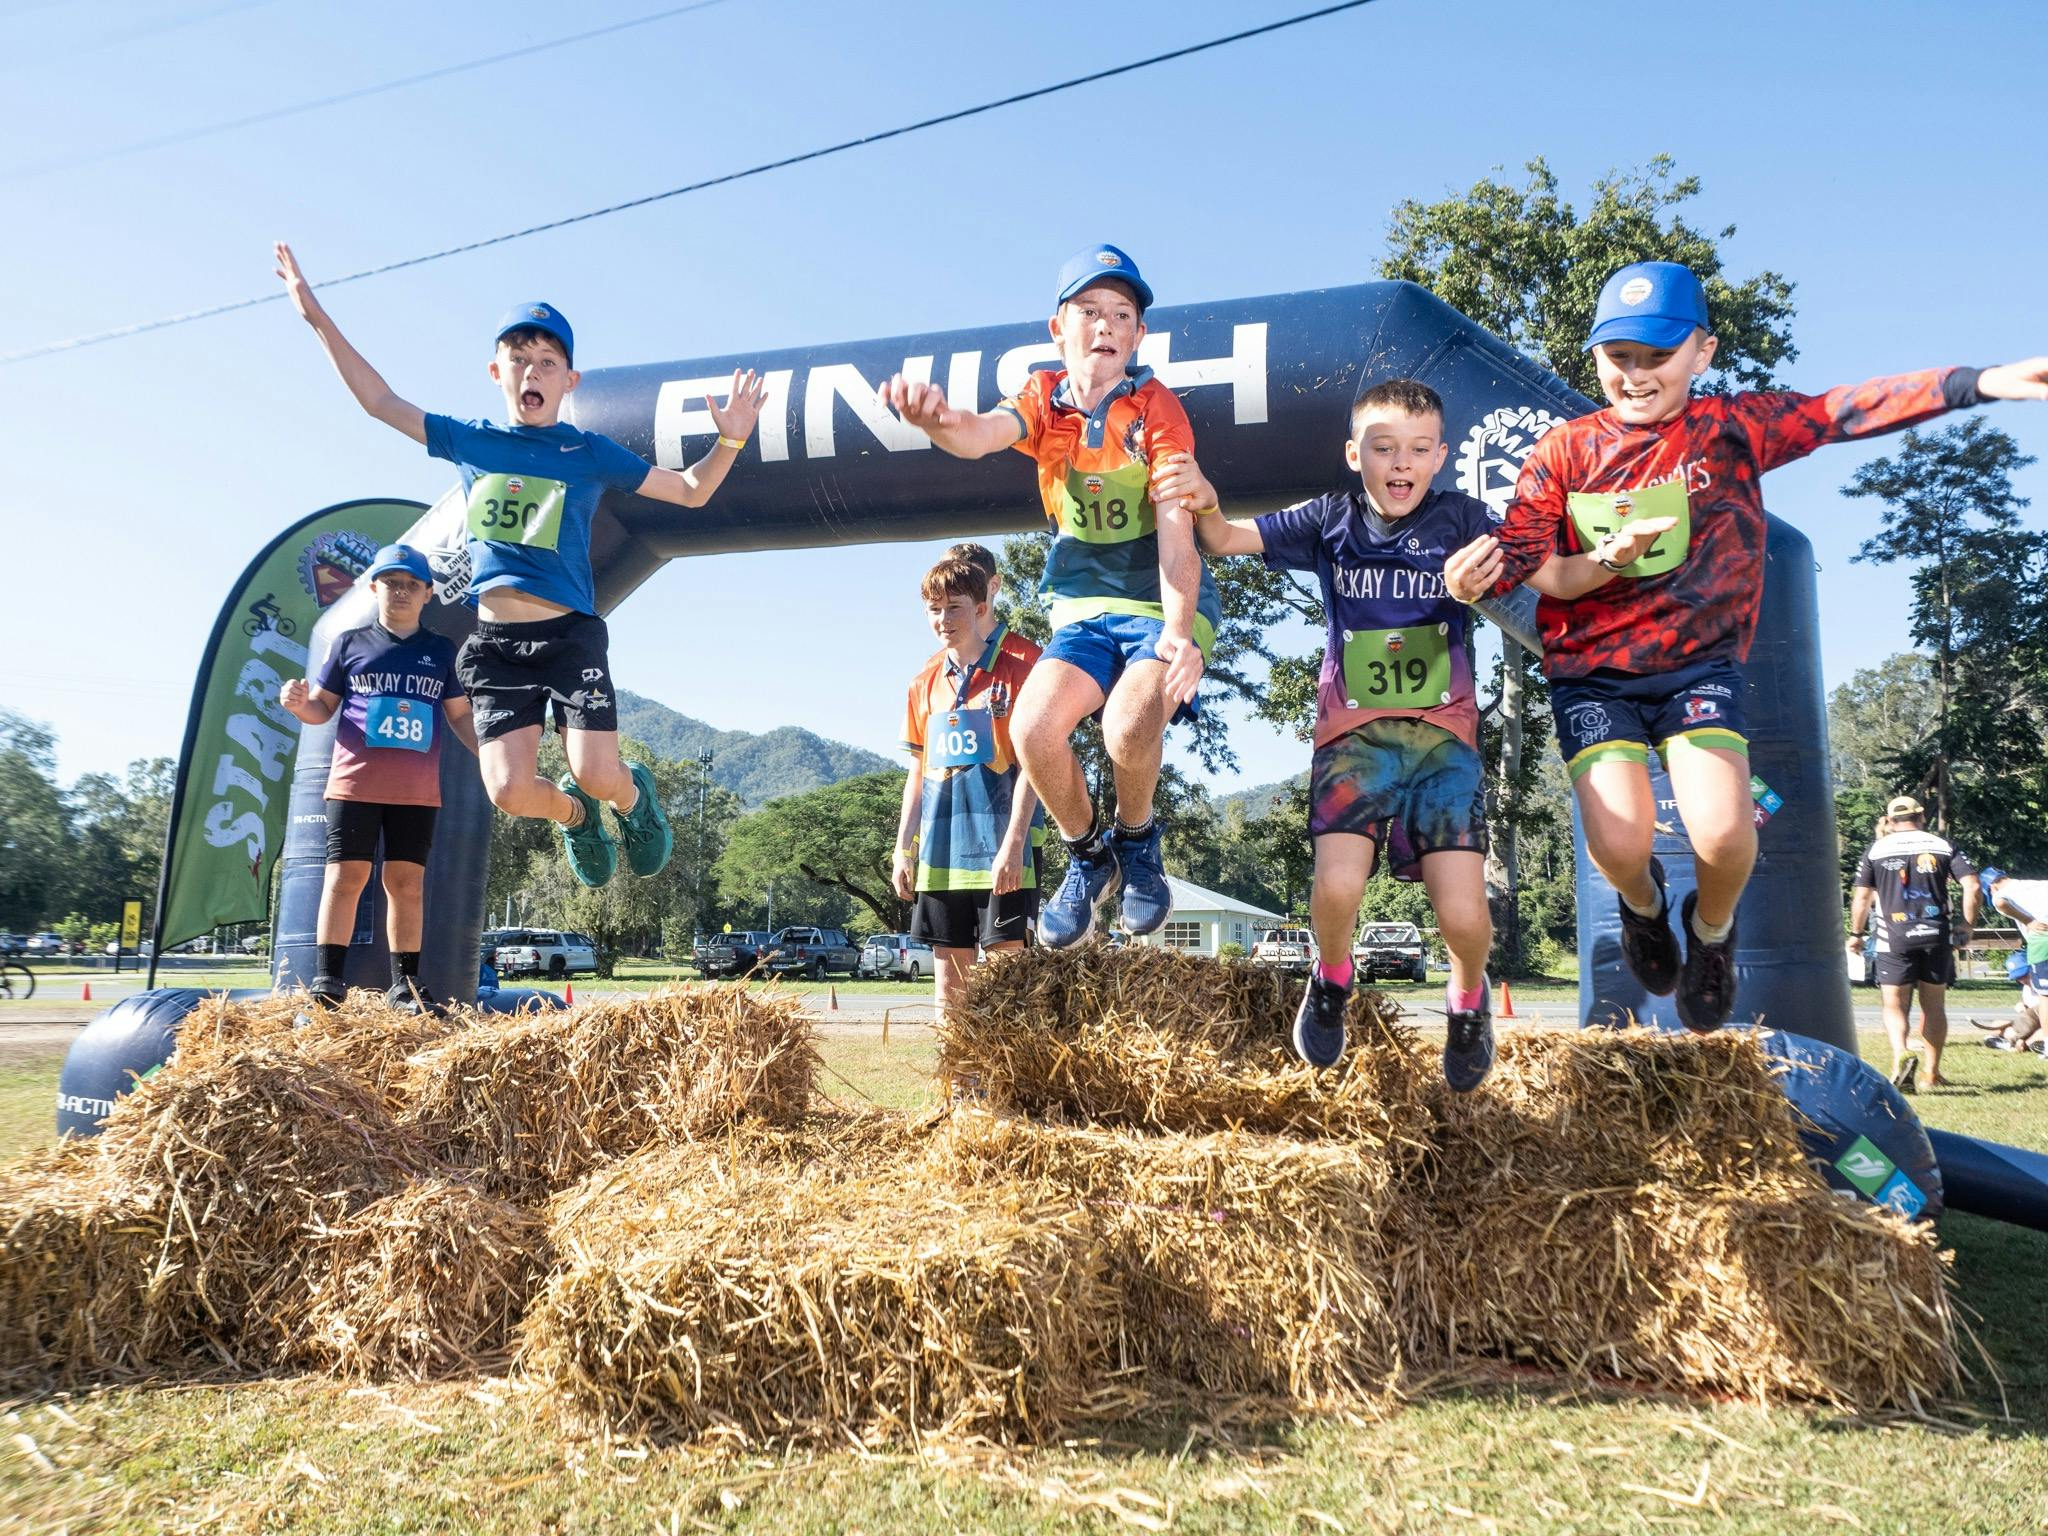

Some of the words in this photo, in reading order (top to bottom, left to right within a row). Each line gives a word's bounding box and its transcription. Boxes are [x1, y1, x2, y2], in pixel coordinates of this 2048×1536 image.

[481, 498, 541, 530] 350
[1073, 495, 1128, 531] 318
[349, 672, 401, 697] MACKAY
[1367, 657, 1428, 696] 319
[377, 715, 423, 742] 438
[935, 729, 979, 758] 403
